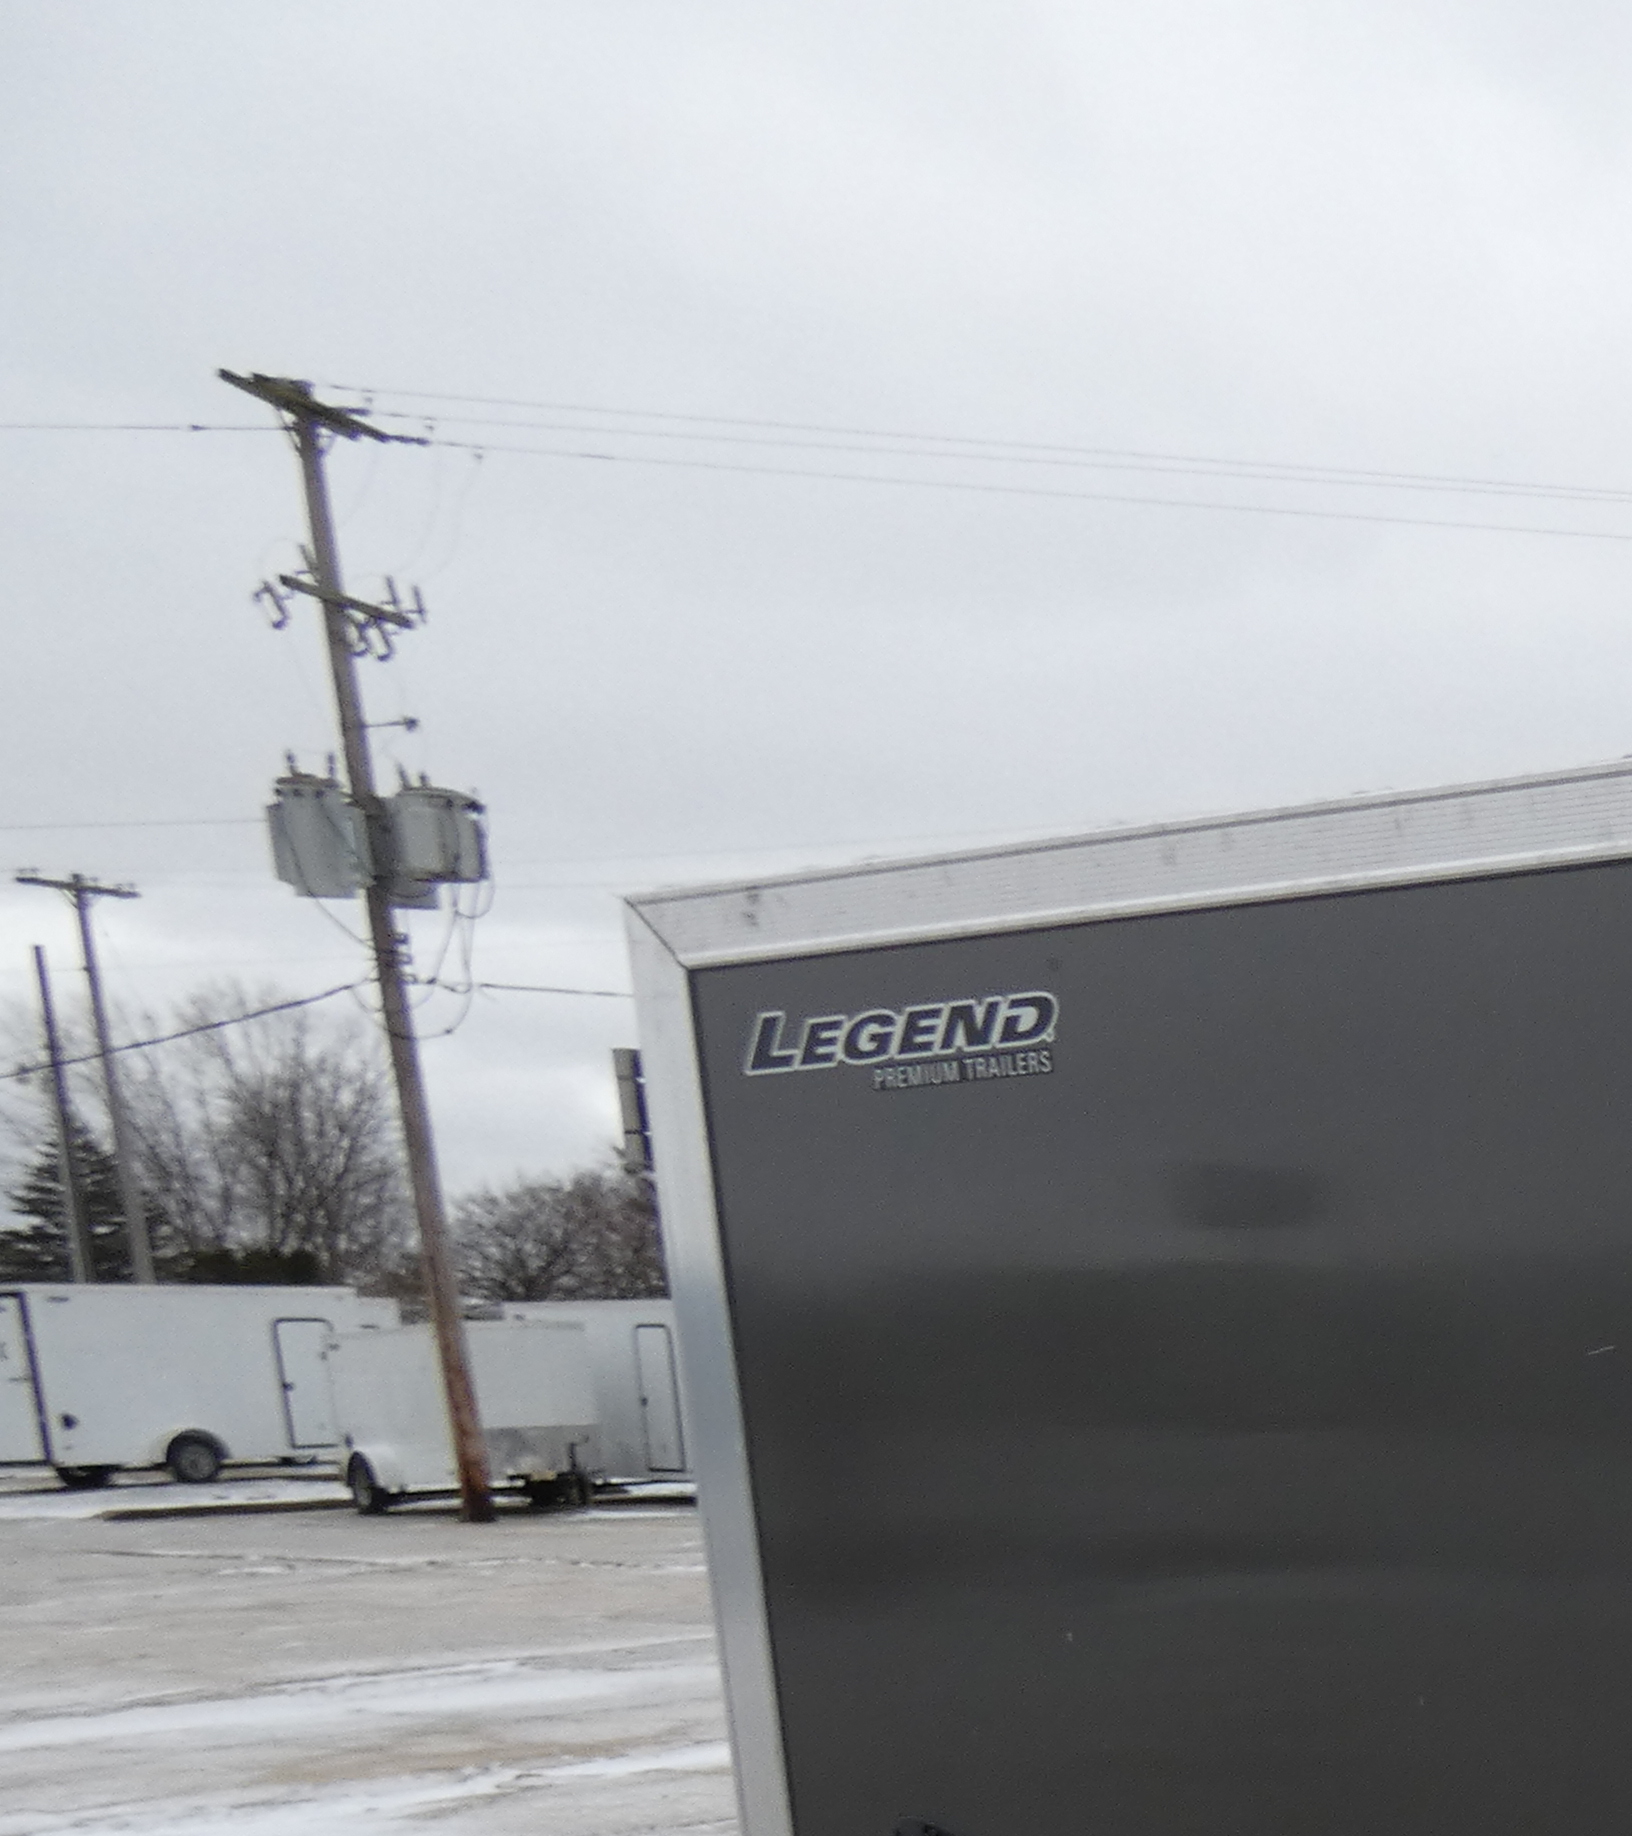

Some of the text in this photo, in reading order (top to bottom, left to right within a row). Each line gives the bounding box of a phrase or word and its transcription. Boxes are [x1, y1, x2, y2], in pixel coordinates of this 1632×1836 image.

[744, 991, 1060, 1076] LEGEND
[872, 1050, 1054, 1090] PREMIUM TRAILERS
